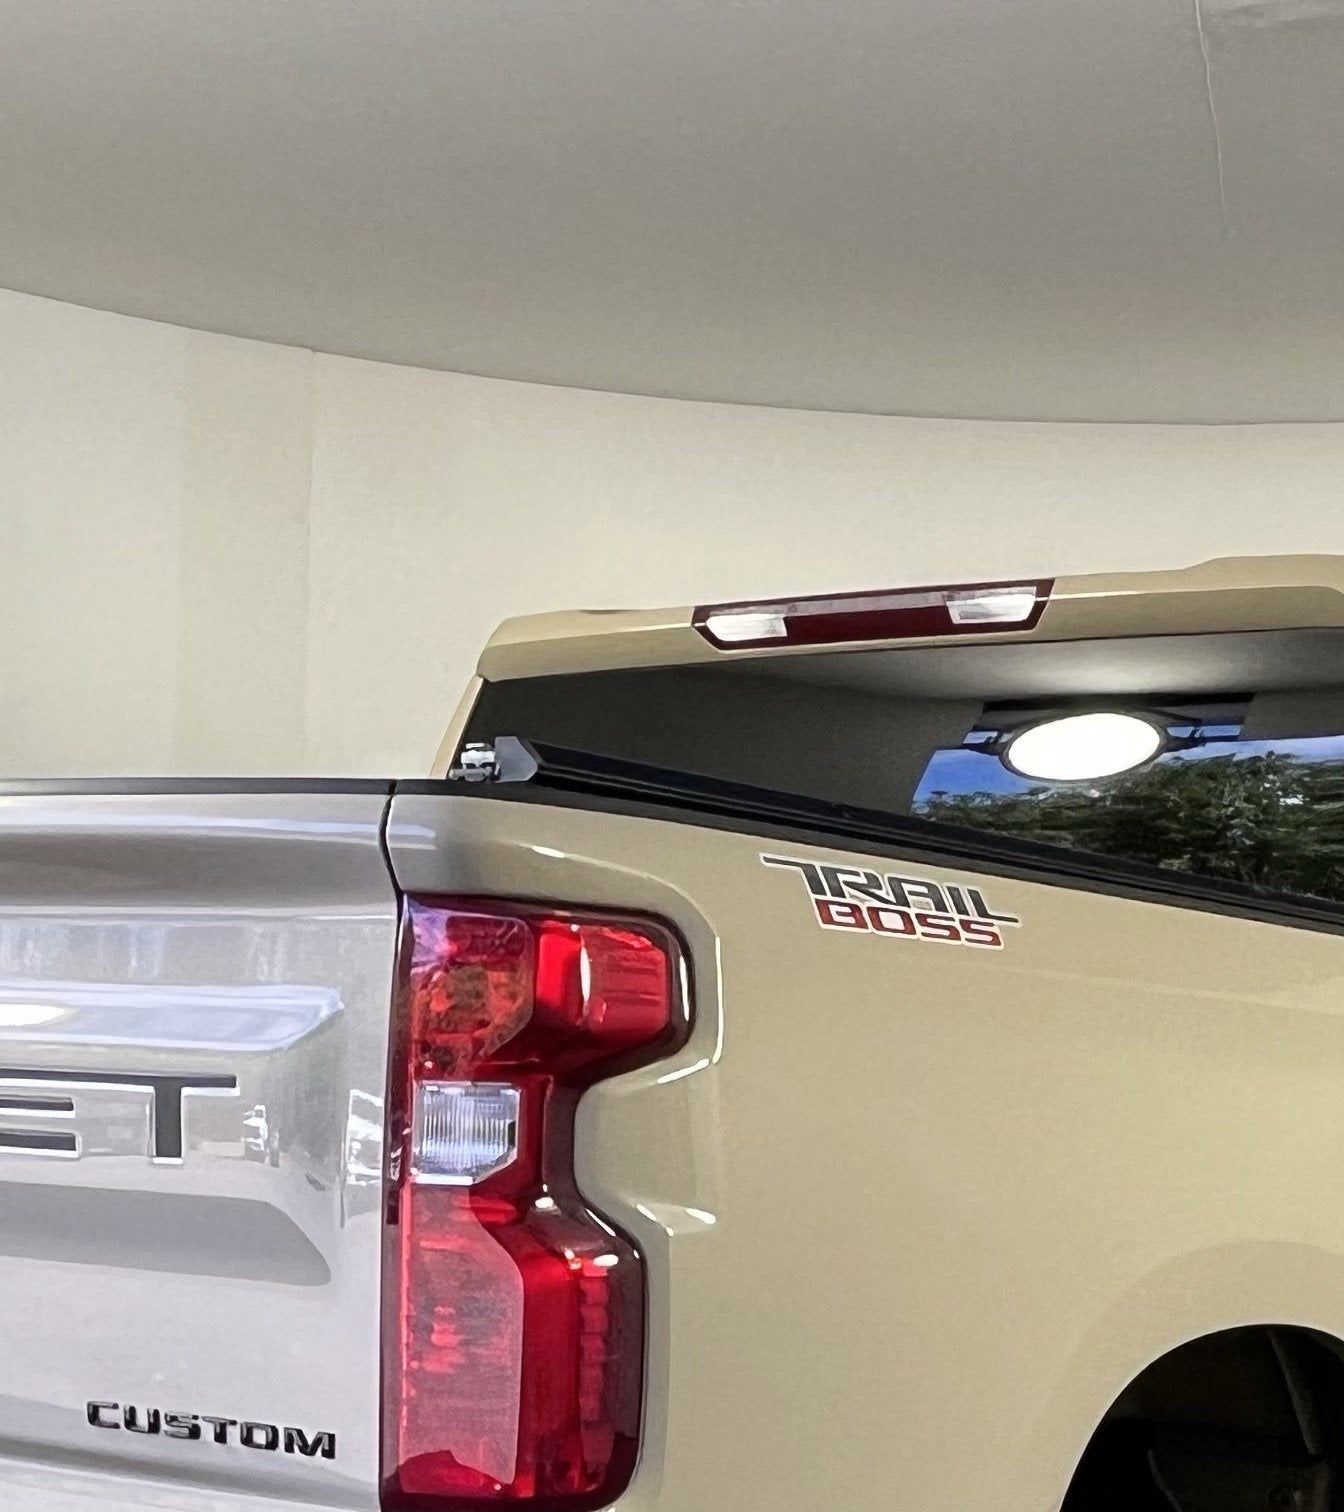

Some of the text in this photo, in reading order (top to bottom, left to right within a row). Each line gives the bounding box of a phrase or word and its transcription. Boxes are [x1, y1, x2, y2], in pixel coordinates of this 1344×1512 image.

[760, 854, 1021, 926] TRAIL
[814, 898, 1004, 948] BOSS
[87, 1400, 336, 1459] CUSTOM
